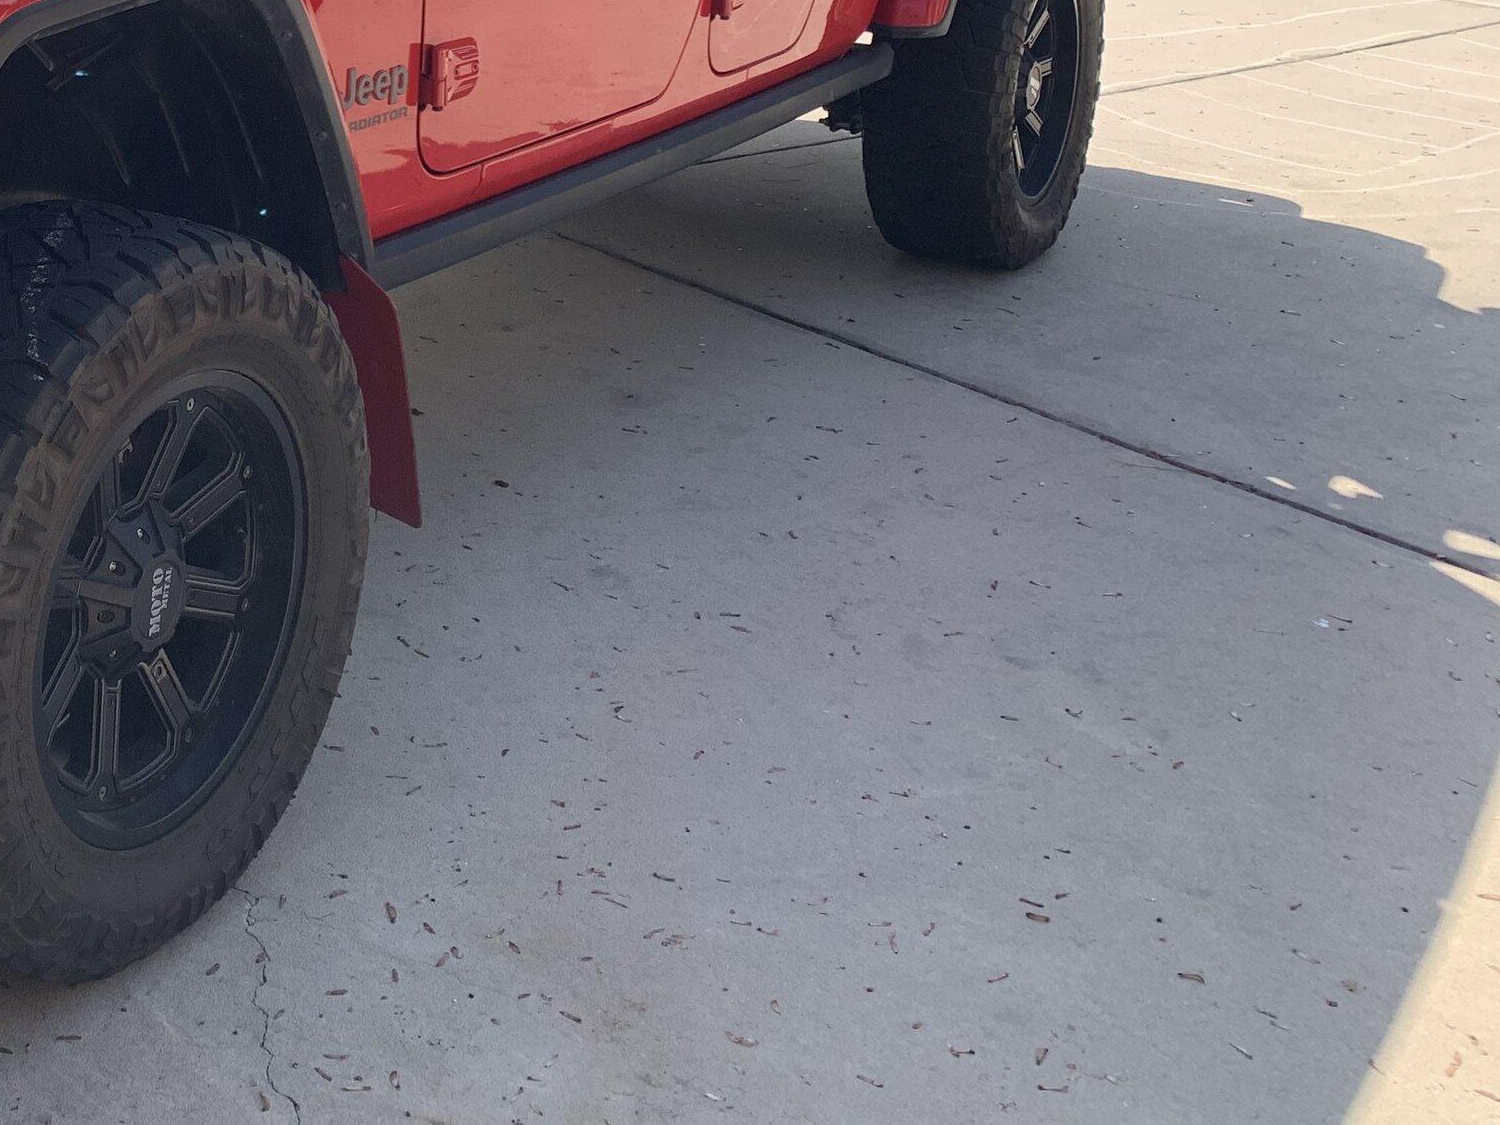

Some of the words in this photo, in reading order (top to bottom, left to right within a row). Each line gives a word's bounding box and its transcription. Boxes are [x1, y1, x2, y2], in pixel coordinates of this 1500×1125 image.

[343, 64, 409, 110] Jeep
[348, 106, 408, 131] ADIATOR
[148, 568, 164, 637] MOTO
